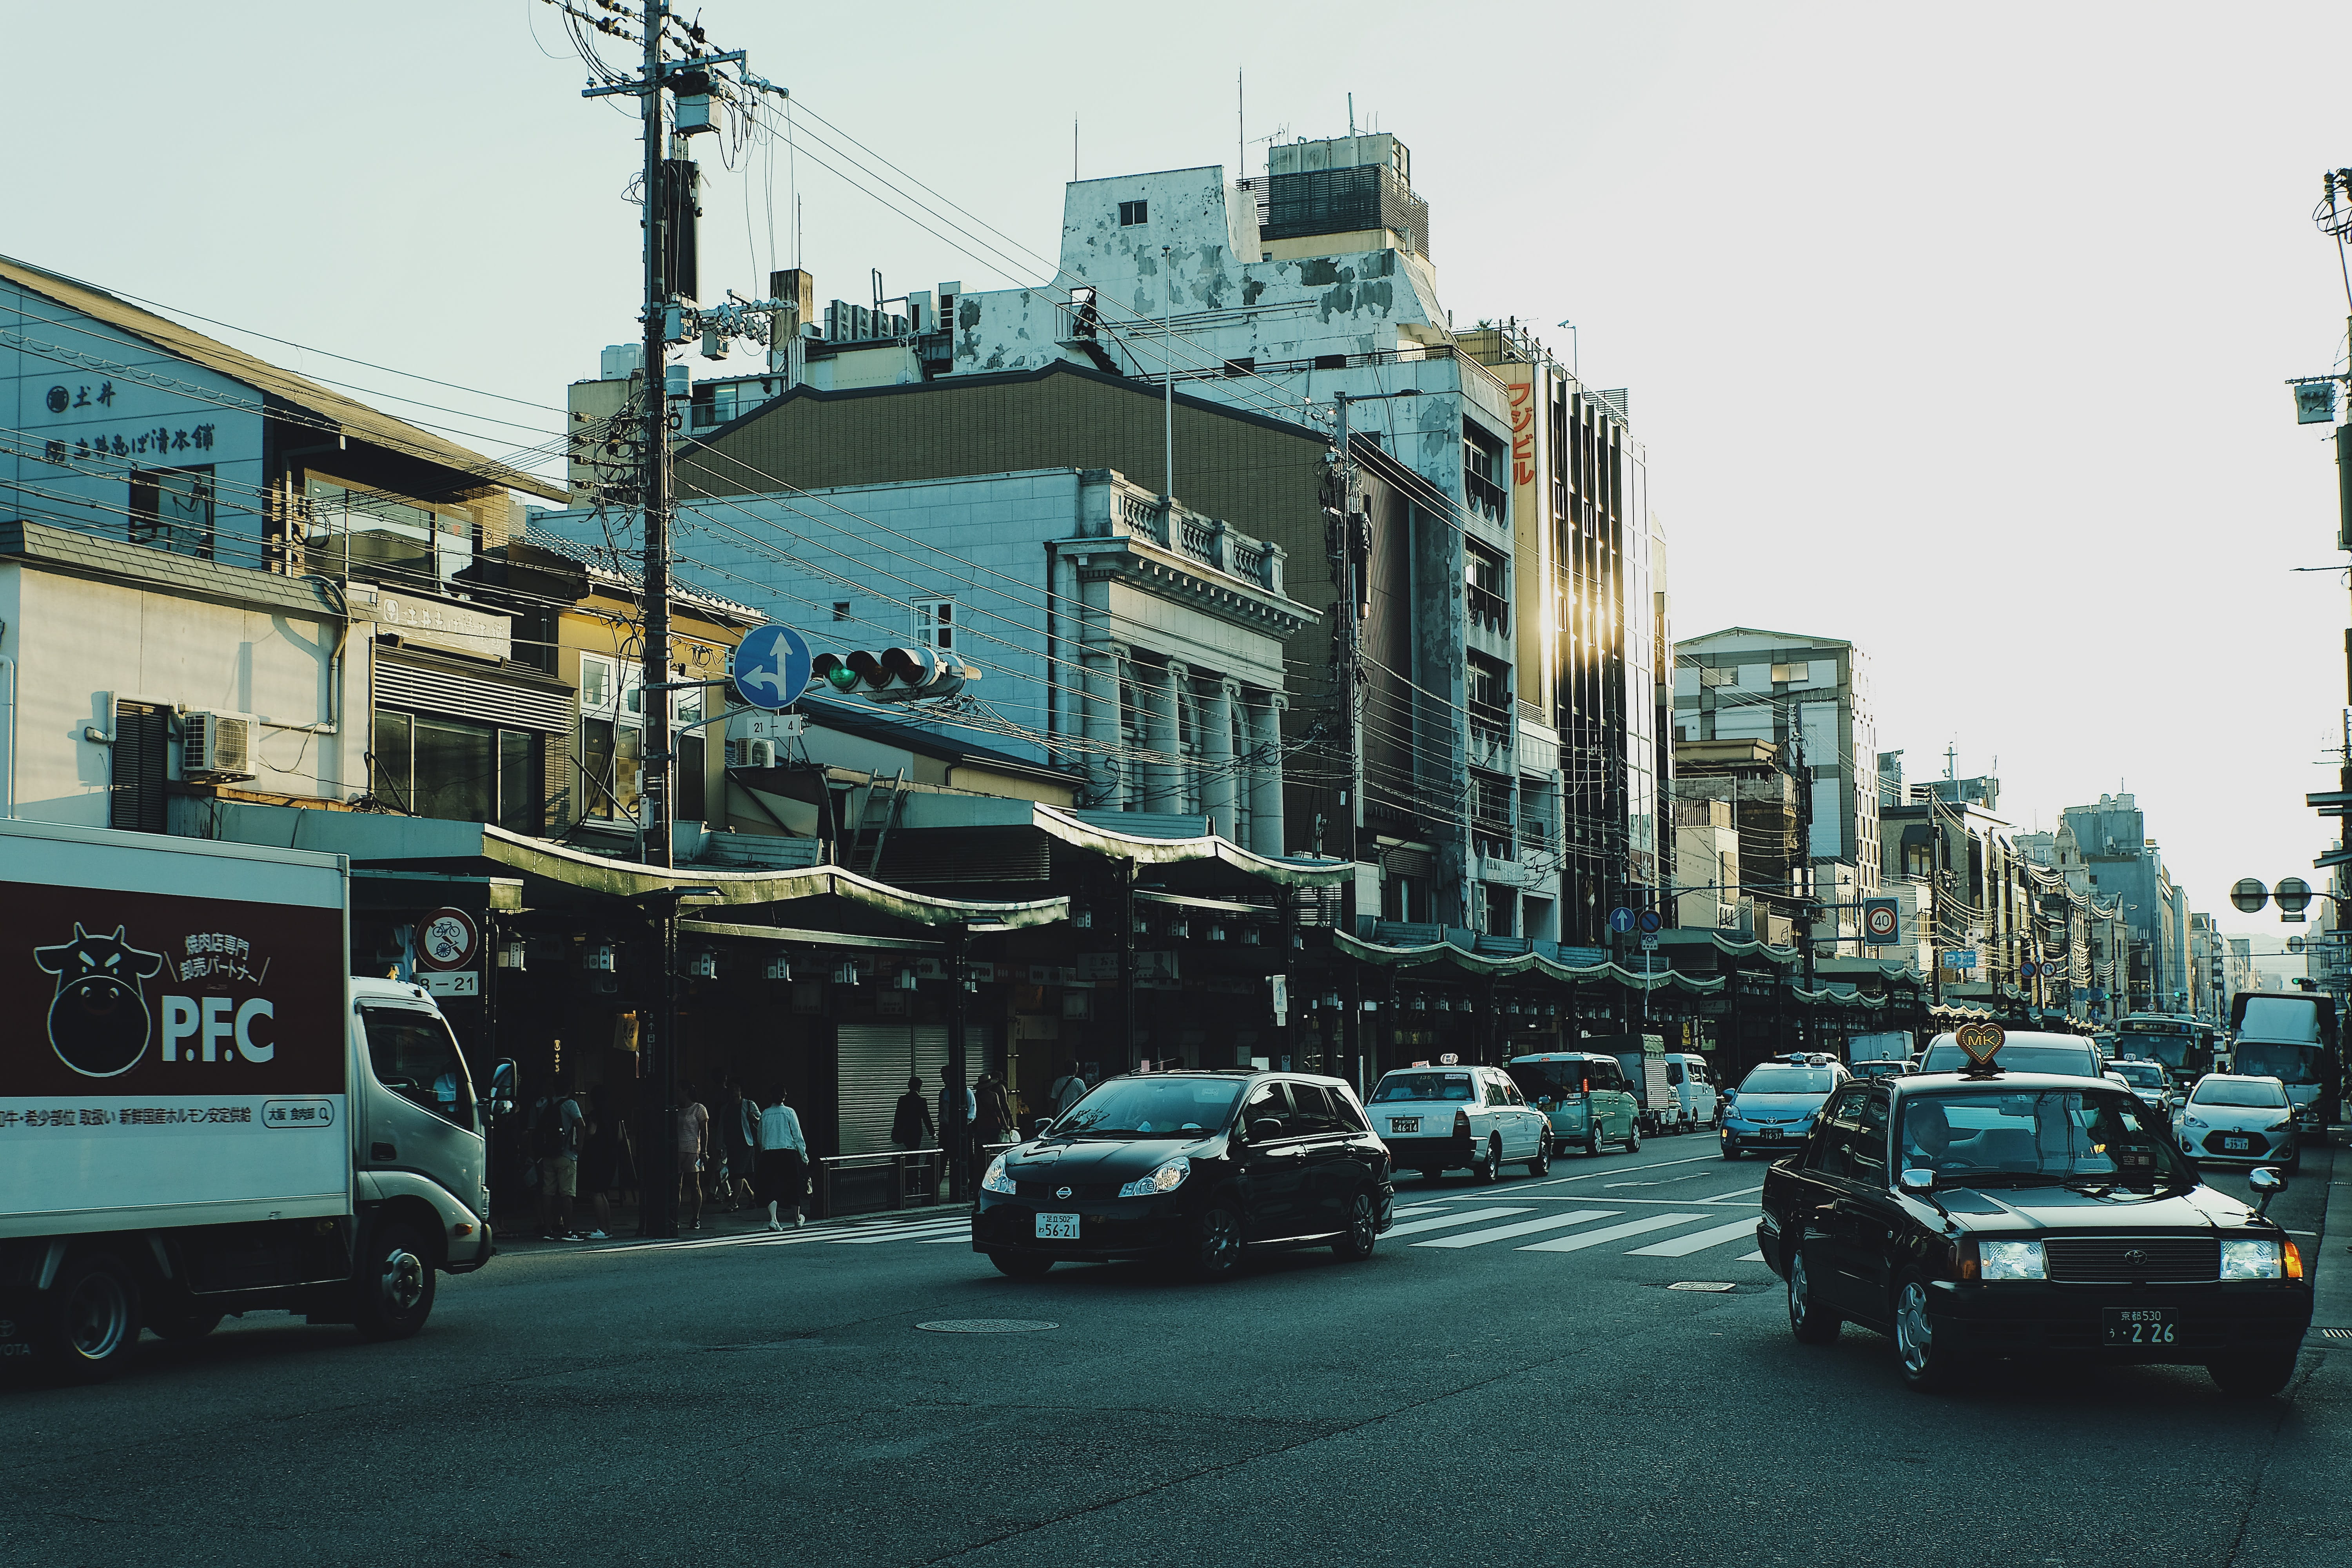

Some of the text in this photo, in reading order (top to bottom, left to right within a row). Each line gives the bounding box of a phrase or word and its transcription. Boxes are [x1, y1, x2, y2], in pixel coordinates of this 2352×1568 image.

[1508, 383, 1534, 485] フジビル
[754, 722, 763, 733] 21
[788, 721, 793, 731] 4
[1875, 915, 1889, 927] 40
[185, 932, 250, 960] 焼肉店専門
[180, 955, 257, 981] 卸売パートナー
[420, 978, 430, 991] 8
[454, 977, 473, 991] 21
[162, 995, 274, 1063] P.F.C
[1968, 1035, 1996, 1045] MK
[80, 1109, 116, 1125] 取扱い
[2123, 1155, 2150, 1165] 空車
[1045, 1223, 1075, 1237] 56-21
